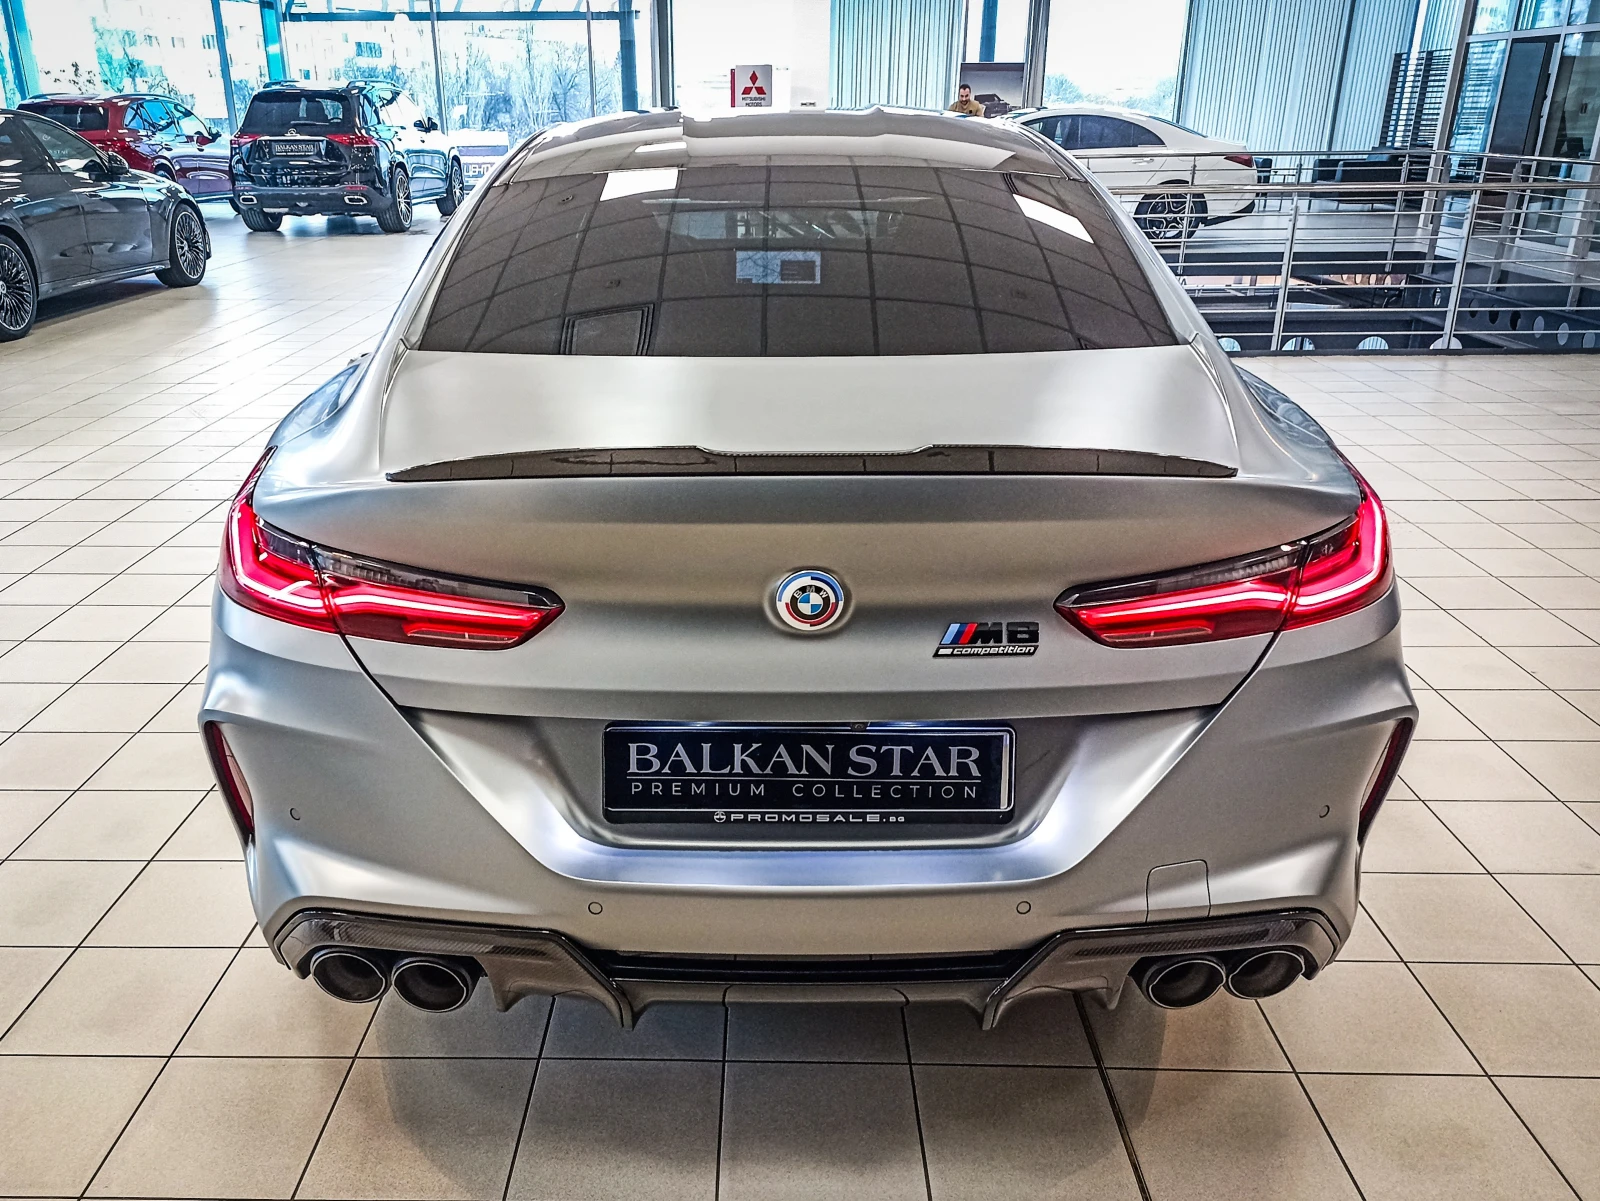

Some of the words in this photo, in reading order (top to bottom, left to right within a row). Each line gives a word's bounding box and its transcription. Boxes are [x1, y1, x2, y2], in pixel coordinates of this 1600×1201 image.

[793, 585, 829, 599] BMW
[952, 645, 1035, 655] competition
[626, 742, 835, 776] BALKAN
[846, 744, 982, 777] STAR
[631, 782, 765, 796] PREMIUM
[792, 783, 977, 799] COLLECTION
